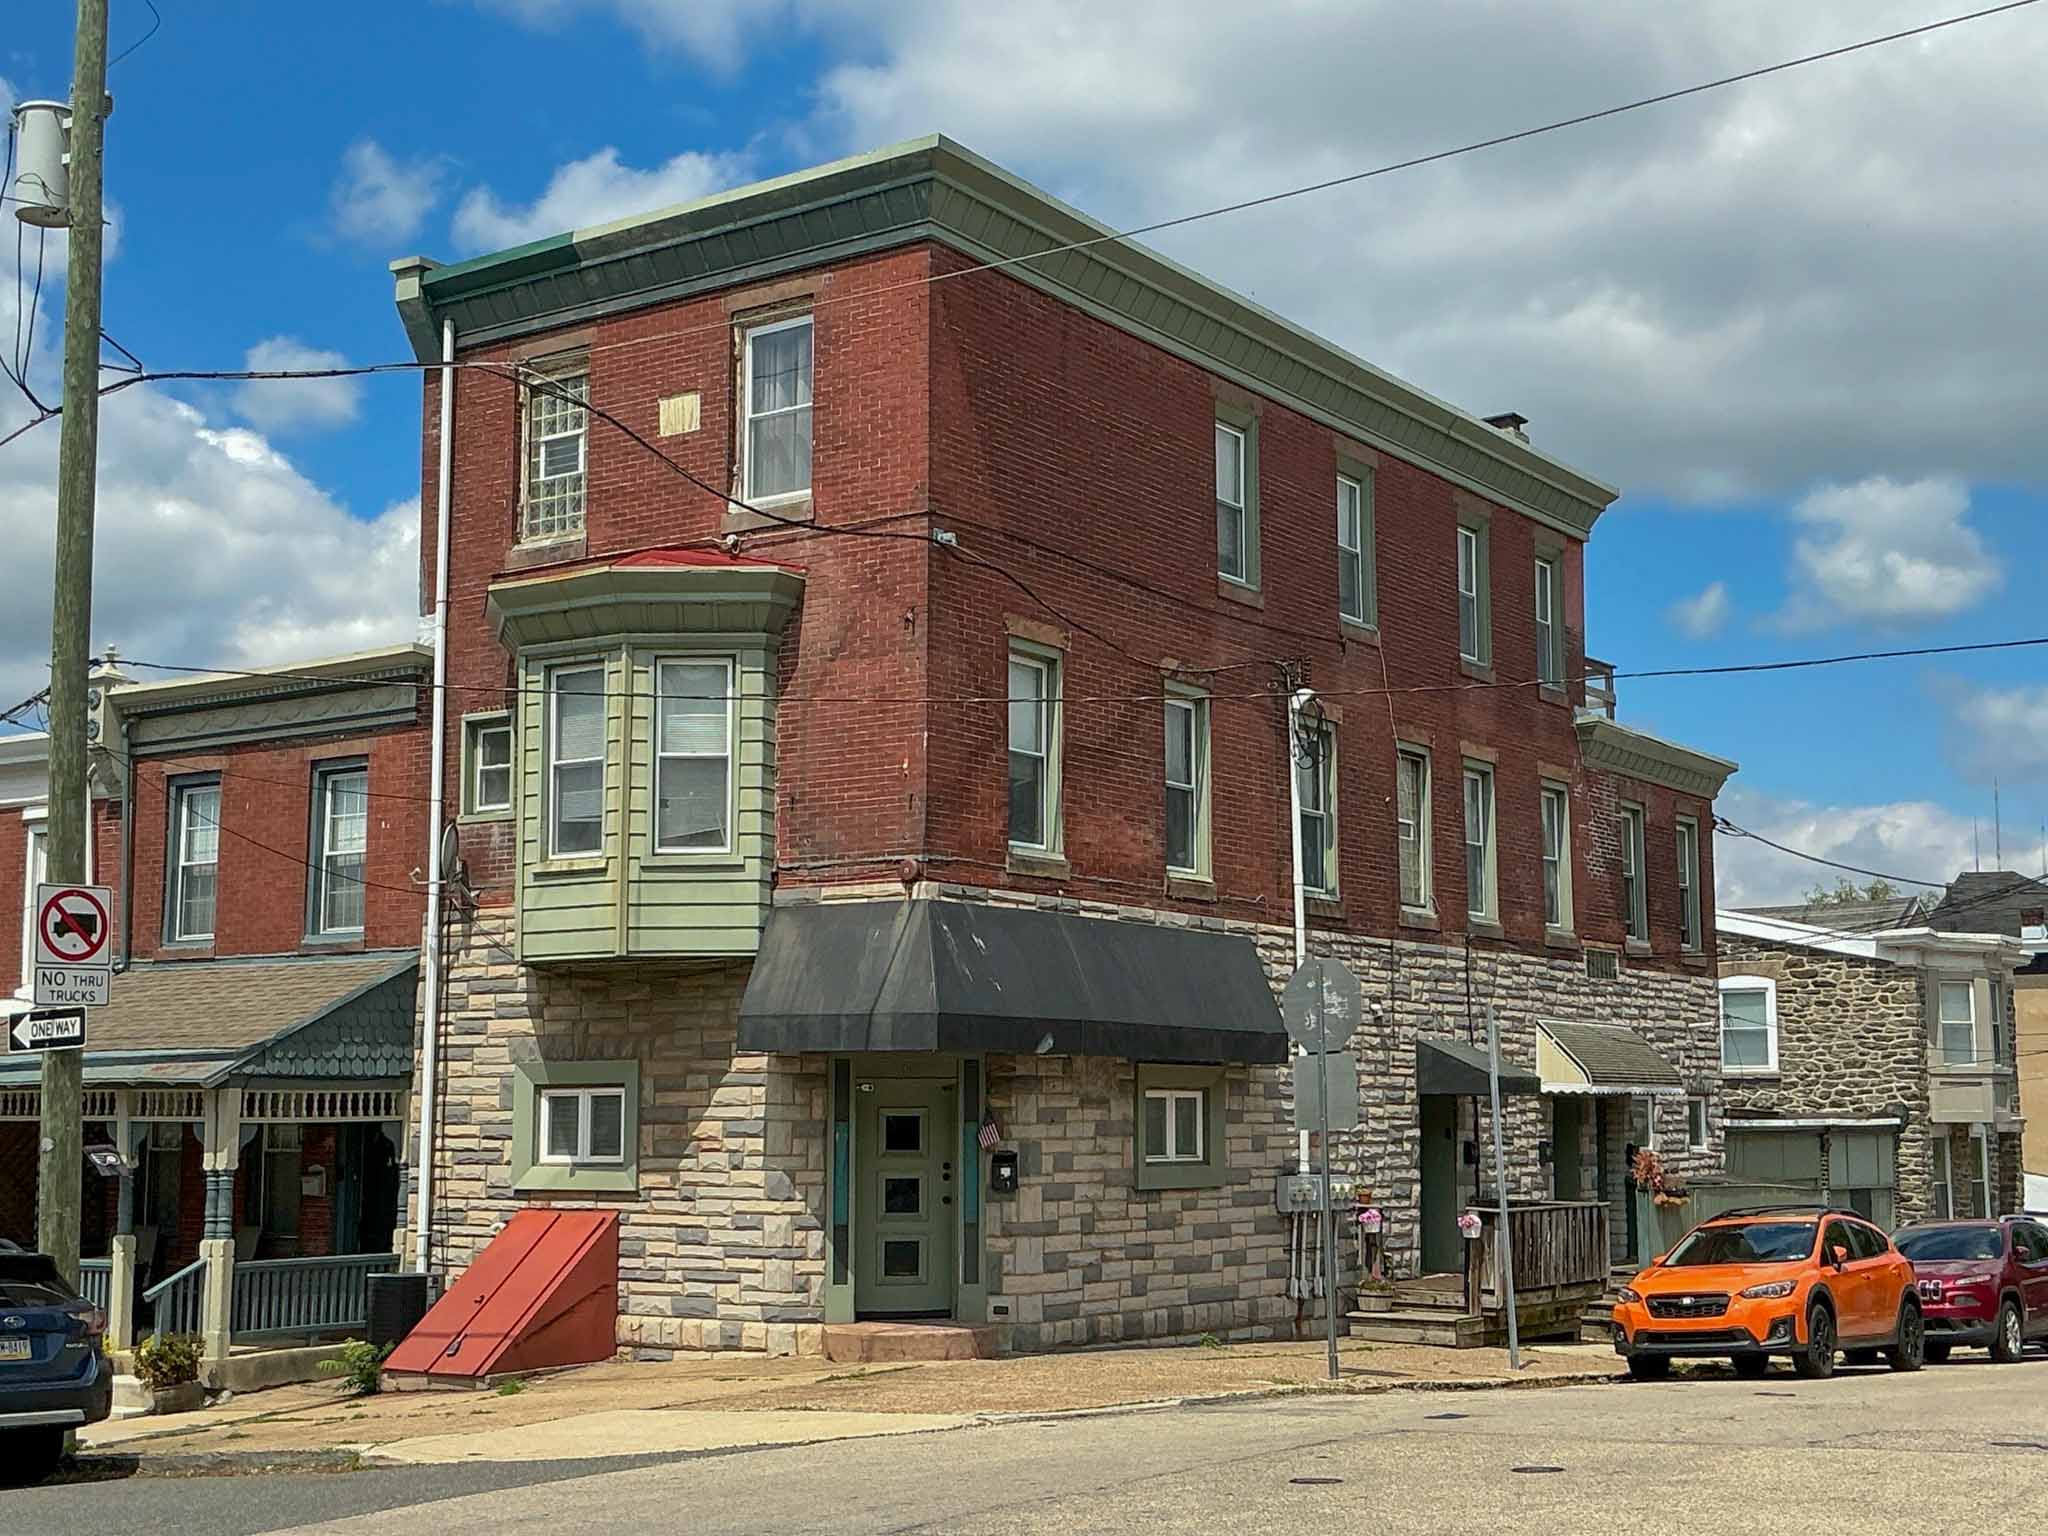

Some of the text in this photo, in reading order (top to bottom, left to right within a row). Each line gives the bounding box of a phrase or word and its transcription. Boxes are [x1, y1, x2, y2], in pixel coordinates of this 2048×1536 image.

[41, 971, 104, 987] NO THRU
[49, 990, 96, 1002] TRUCKS
[31, 1020, 77, 1038] ONE WAY
